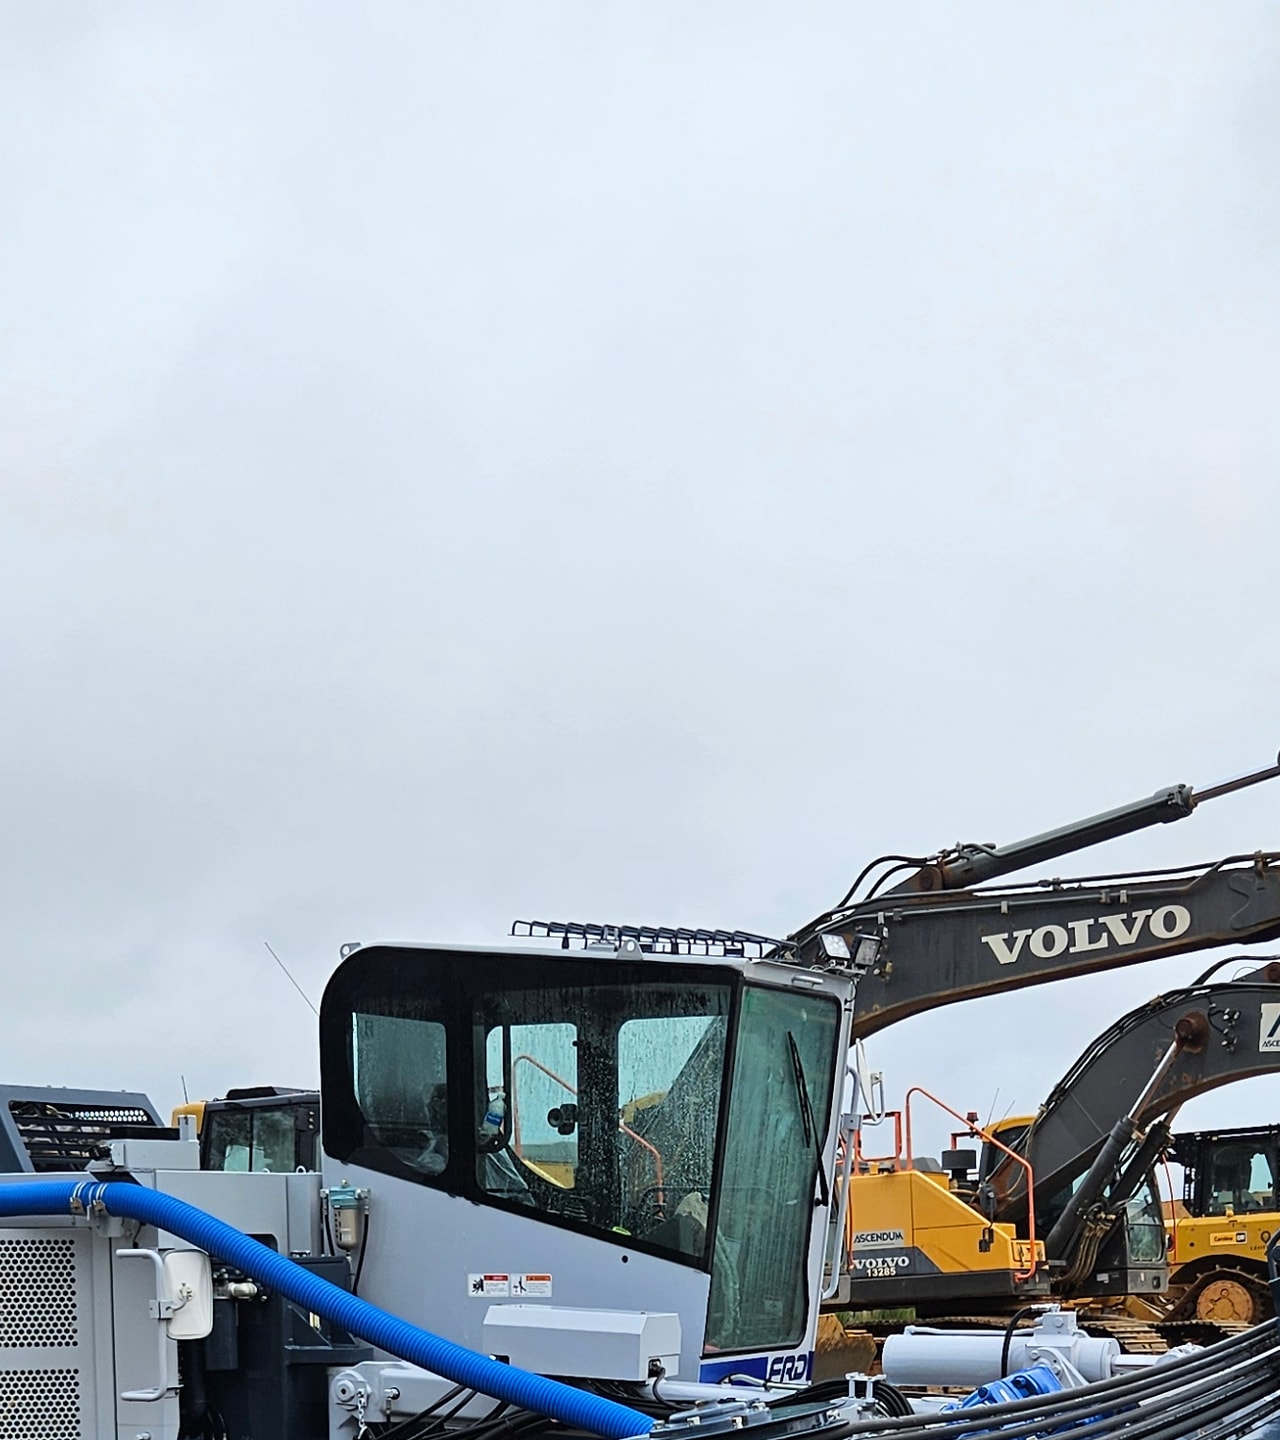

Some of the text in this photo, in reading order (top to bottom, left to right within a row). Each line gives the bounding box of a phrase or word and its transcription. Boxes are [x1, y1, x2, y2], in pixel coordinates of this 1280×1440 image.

[981, 904, 1191, 965] VOLVO
[853, 1231, 904, 1244] ASCENDUM
[852, 1256, 910, 1270] VOLVO
[866, 1267, 896, 1277] 13285
[769, 1354, 807, 1383] FRD
